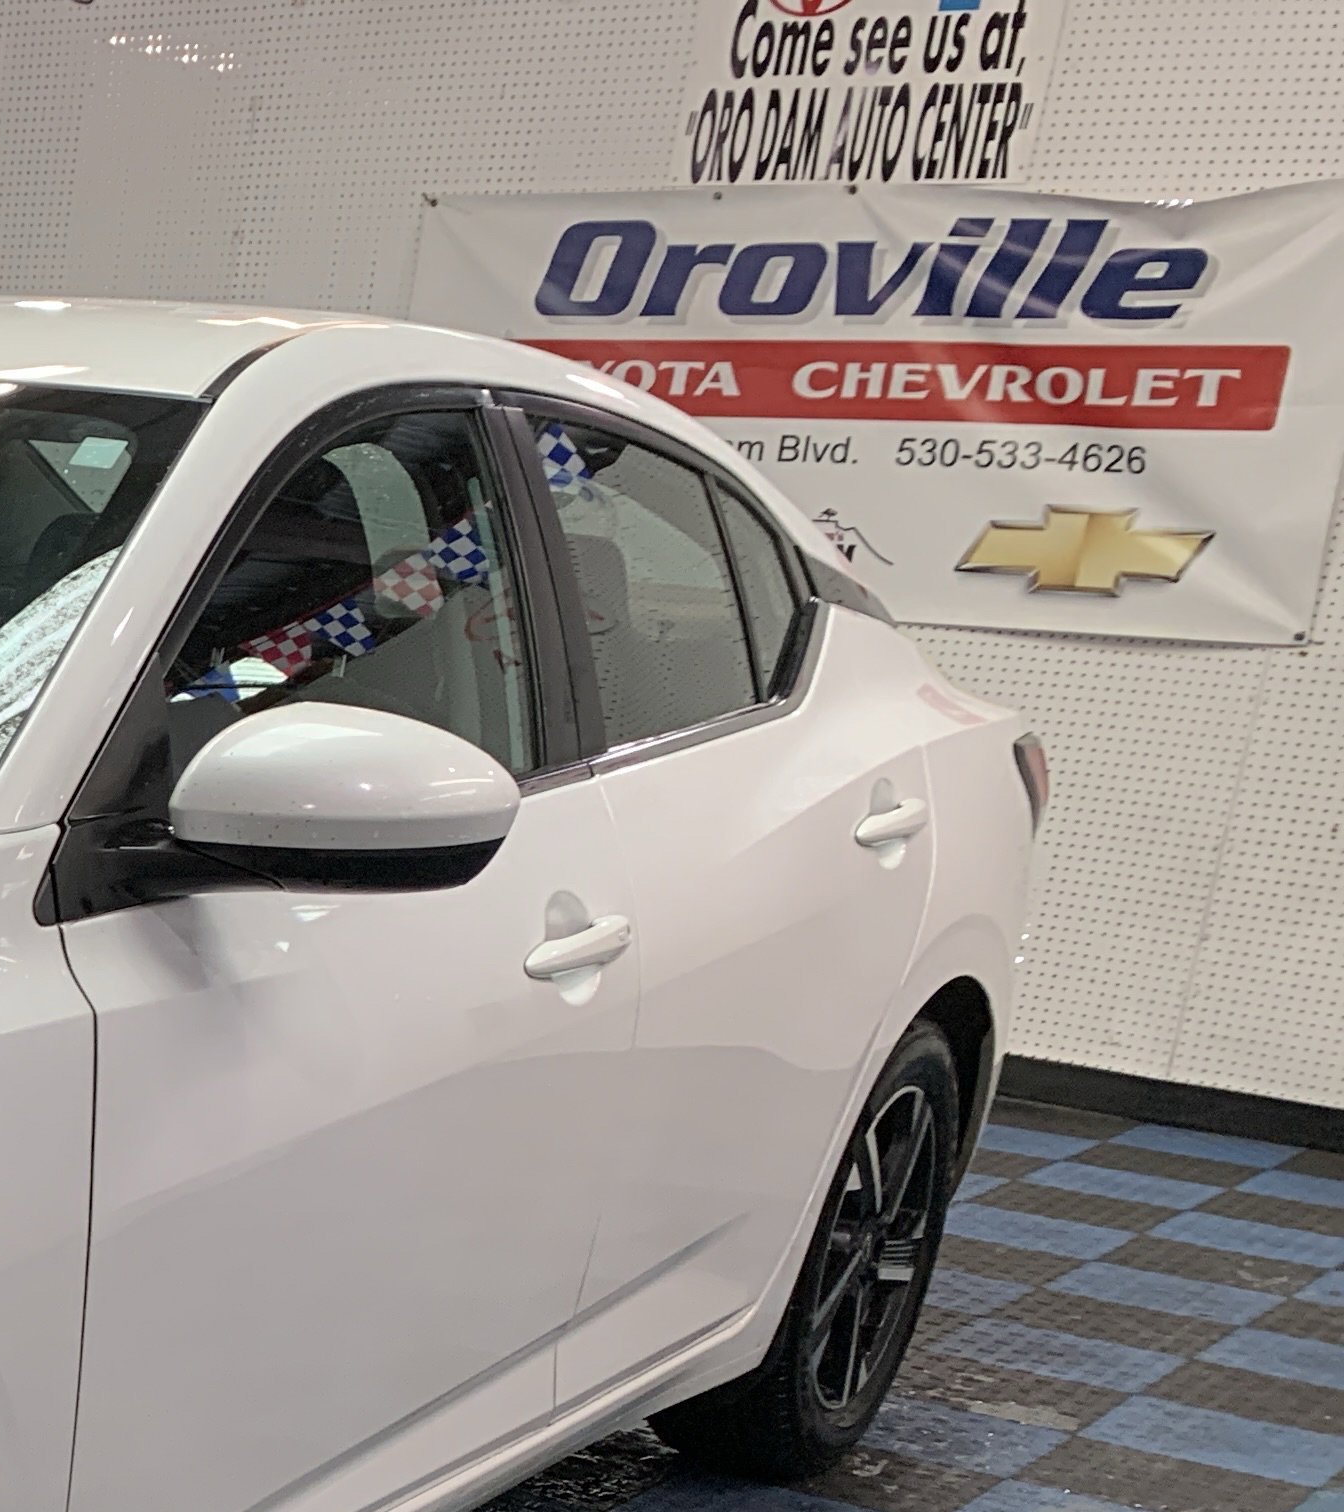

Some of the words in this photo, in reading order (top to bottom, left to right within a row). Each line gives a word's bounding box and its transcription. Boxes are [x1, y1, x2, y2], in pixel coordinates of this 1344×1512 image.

[730, 0, 835, 78] Come
[843, 16, 912, 75] see
[922, 12, 969, 73] us
[685, 87, 755, 183] "ORO
[753, 87, 829, 181] DAM
[817, 83, 910, 181] AUTO
[911, 82, 1034, 182] CENTER"
[534, 218, 1211, 321] Oroville
[792, 360, 1242, 408] CHEVROLET
[777, 435, 859, 465] Blvd.
[895, 438, 1147, 475] 530-533-4626
